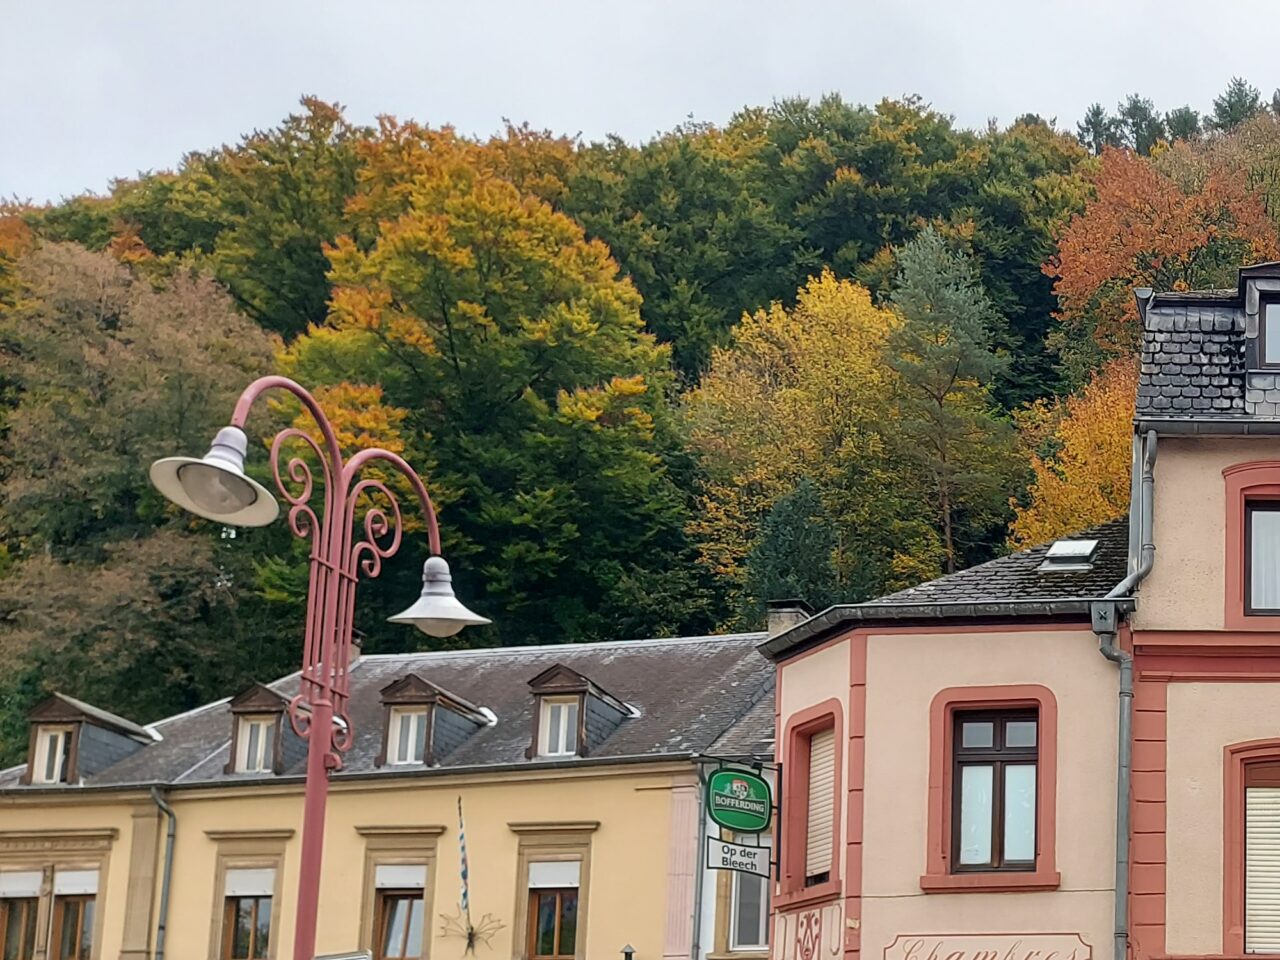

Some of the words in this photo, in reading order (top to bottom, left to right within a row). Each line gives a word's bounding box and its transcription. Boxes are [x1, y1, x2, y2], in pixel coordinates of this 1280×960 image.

[715, 795, 765, 812] BOFFERDING
[721, 845, 737, 856] Op
[739, 848, 758, 859] der
[721, 857, 757, 871] Bleech
